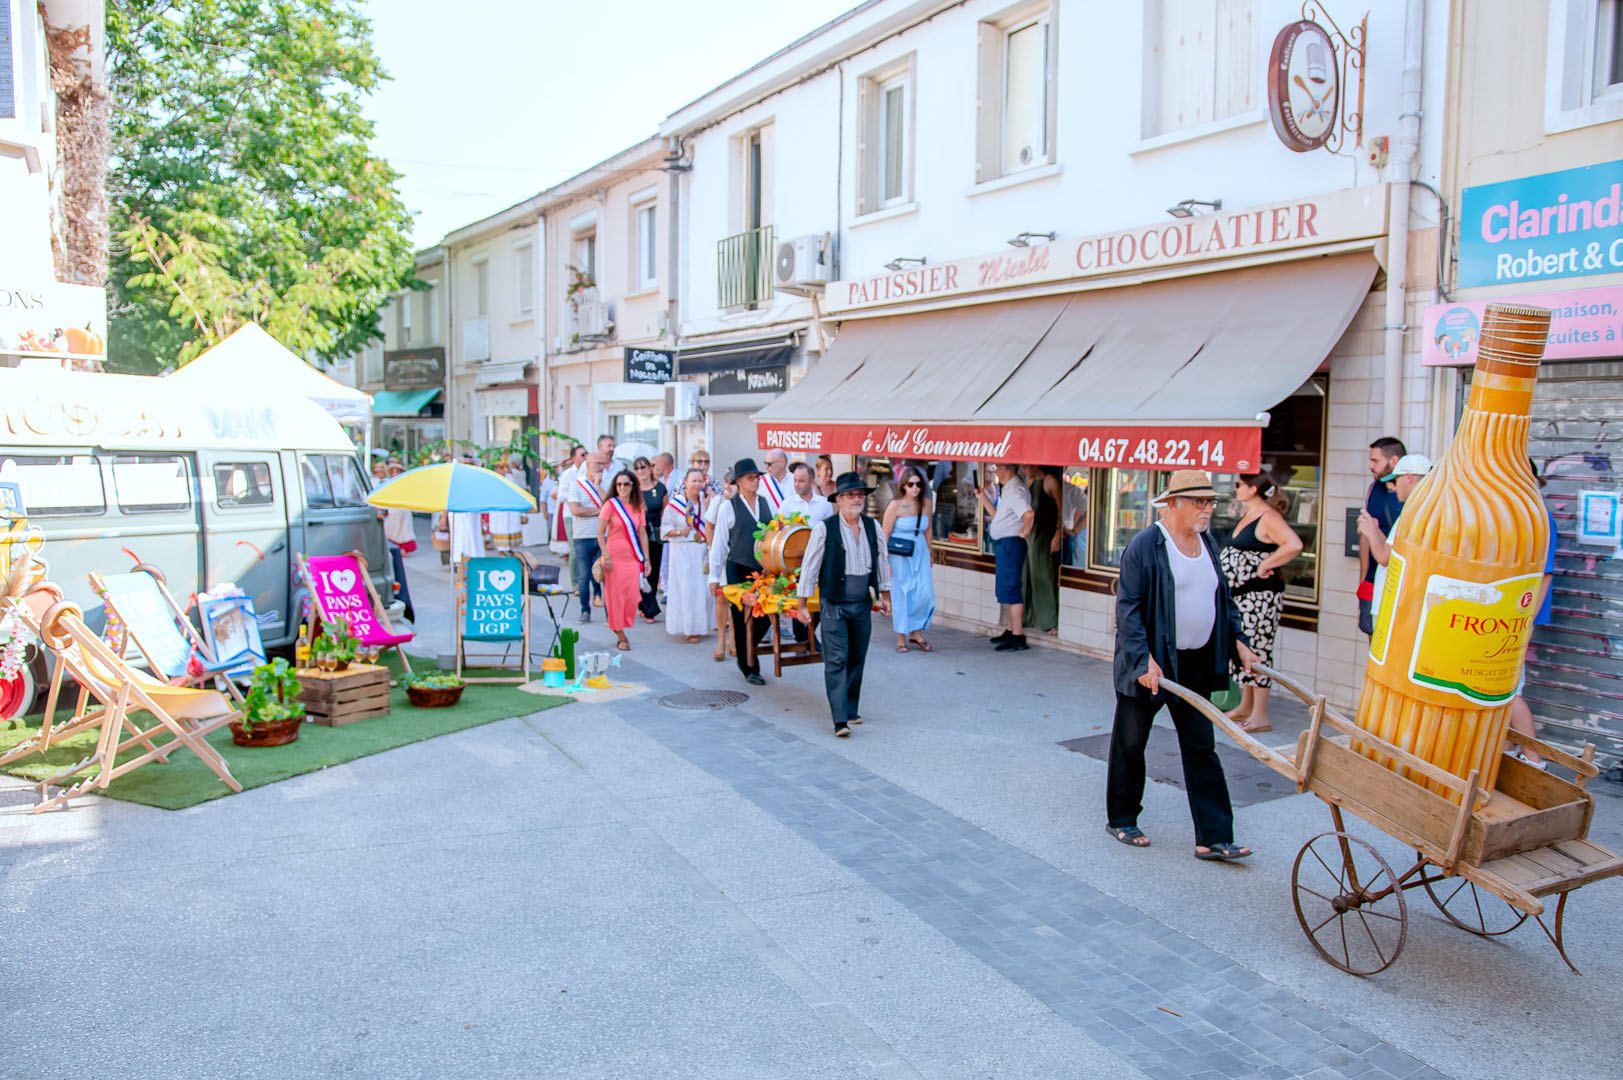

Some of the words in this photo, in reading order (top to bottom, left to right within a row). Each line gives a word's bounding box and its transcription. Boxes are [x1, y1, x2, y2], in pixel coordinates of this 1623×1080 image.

[1481, 183, 1623, 243] Clarind
[848, 264, 959, 305] PATISSIER
[1076, 202, 1319, 270] CHOCOLATIER
[1496, 247, 1579, 280] Robert
[1583, 241, 1604, 271] &
[766, 430, 823, 450] PATISSERIE
[875, 427, 910, 453] Nid
[912, 428, 1012, 459] Gourmand
[1078, 437, 1225, 467] 04.67.48.22.14
[476, 570, 488, 592] I
[324, 594, 363, 610] PAYS
[475, 593, 515, 608] PAYS
[472, 608, 518, 621] D'OC
[479, 622, 510, 634] IGP
